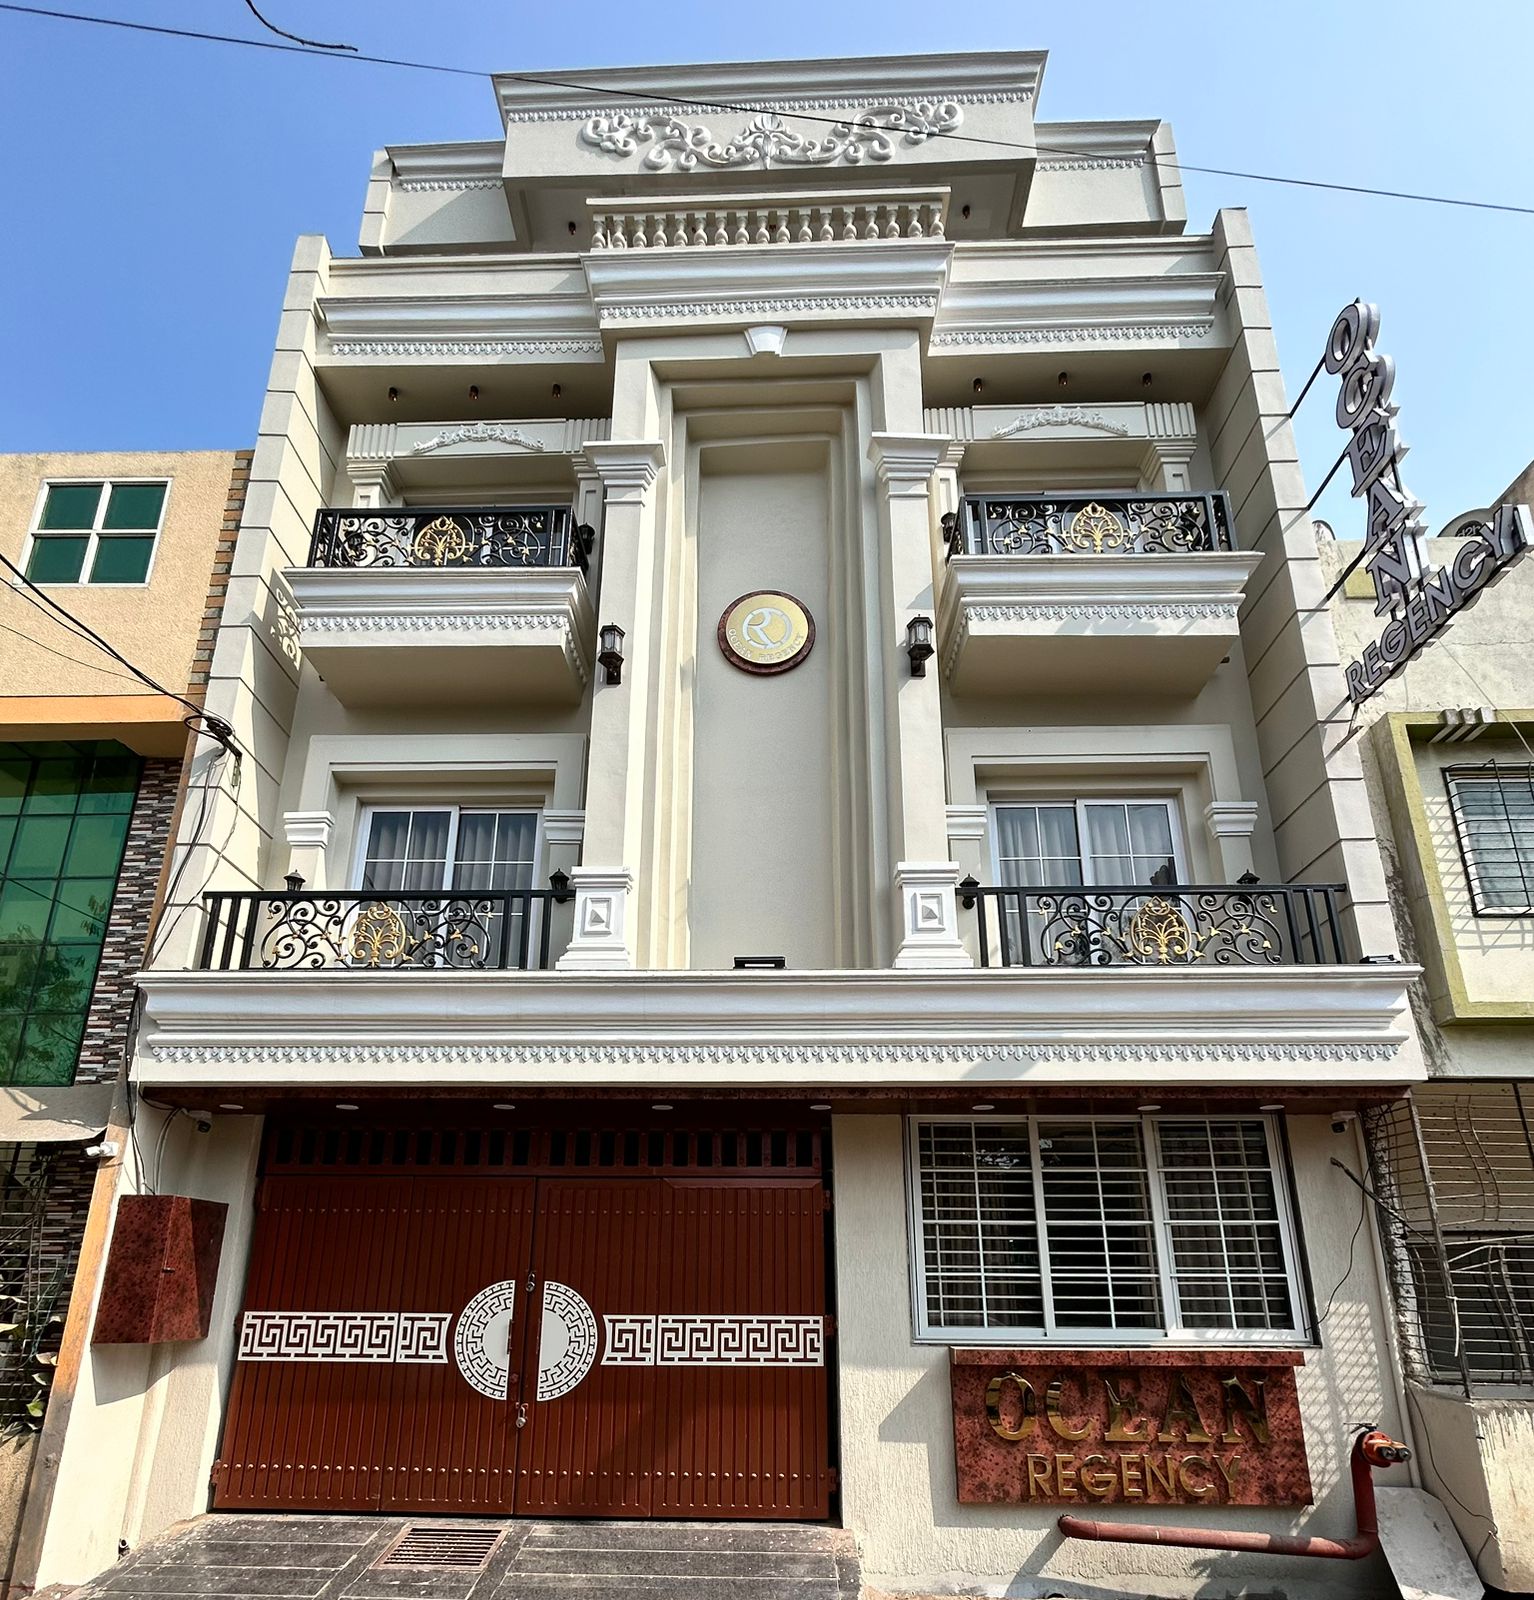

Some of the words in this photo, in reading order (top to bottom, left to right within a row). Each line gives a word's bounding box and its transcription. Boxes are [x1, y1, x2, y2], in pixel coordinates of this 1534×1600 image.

[1325, 302, 1411, 618] OCEAN
[1345, 504, 1515, 704] REGENCY
[985, 1371, 1270, 1443] OCEAN
[1026, 1453, 1241, 1498] REGENCY
